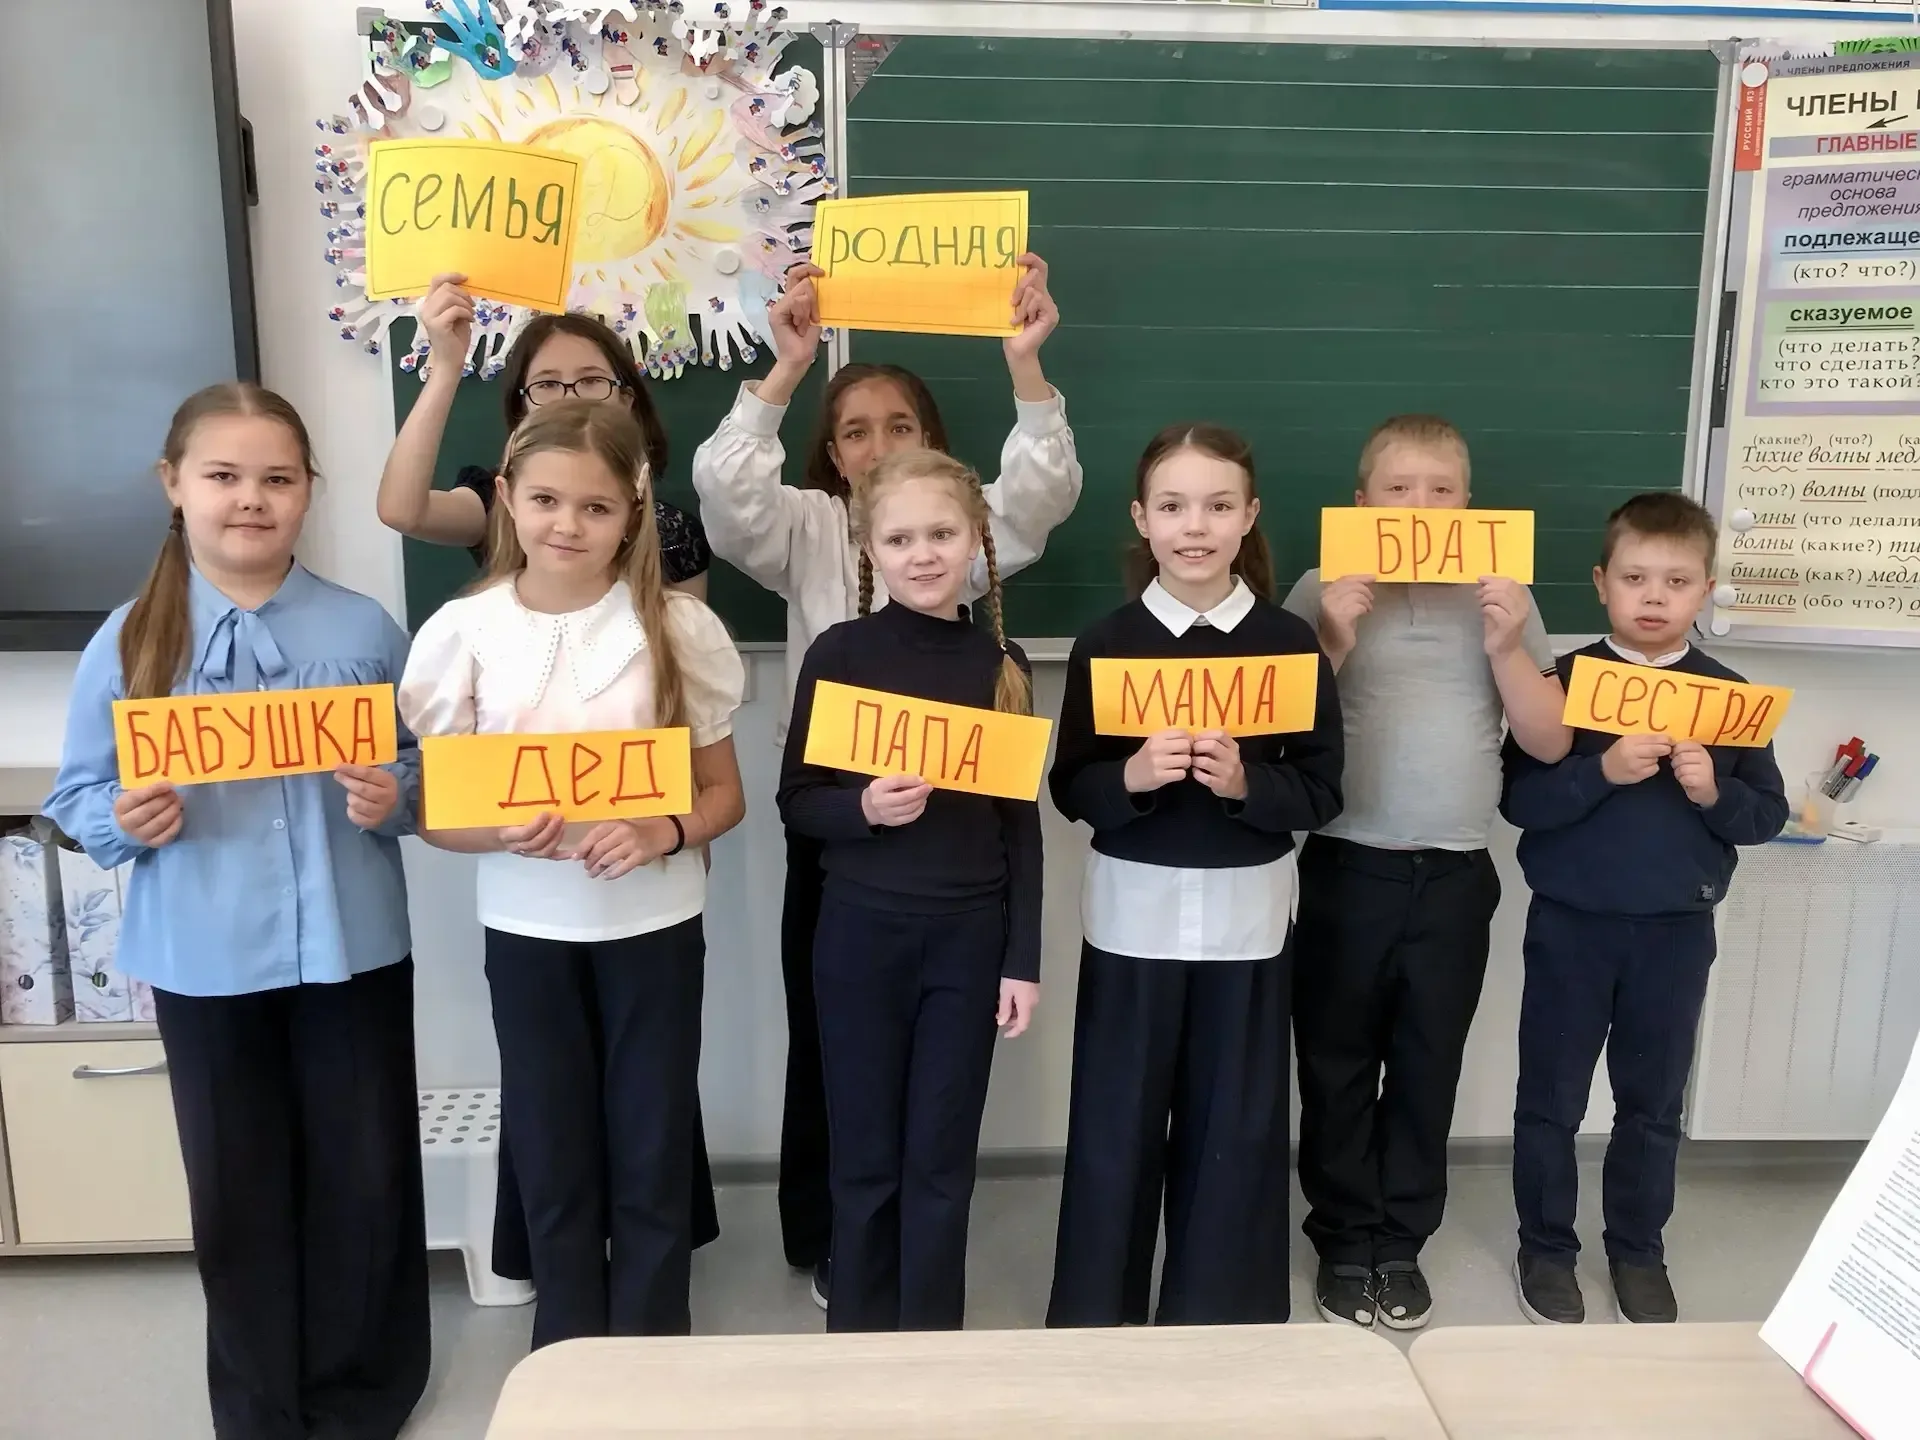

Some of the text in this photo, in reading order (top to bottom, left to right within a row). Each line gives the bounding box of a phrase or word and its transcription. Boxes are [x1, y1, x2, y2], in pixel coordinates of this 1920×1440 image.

[1787, 66, 1825, 76] ЧЛЕНЫ
[1828, 60, 1911, 73] ПРЕДЛОЖЕНИЯ
[1787, 90, 1897, 117] ЧЛЕНЫ
[1743, 108, 1754, 151] РУССКИЙ
[1817, 133, 1918, 153] ГЛАВНЫЕ
[1830, 186, 1897, 201] основа
[829, 225, 1016, 279] РОДНАЯ
[1793, 260, 1916, 283] (кто? что?)
[1790, 305, 1913, 324] сказуемое
[1778, 336, 1920, 358] (что делать?
[1774, 354, 1920, 372] что сделать?
[1760, 378, 1795, 389] кто
[1804, 377, 1839, 389] это
[1753, 434, 1813, 447] (какие?)
[1829, 433, 1873, 447] (что?)
[1742, 446, 1803, 464] Тихие
[1808, 446, 1871, 464] волны
[1738, 483, 1795, 500] (что?)
[1802, 480, 1867, 498] волны
[1803, 512, 1842, 529] (что
[1377, 514, 1507, 581] БРАТ
[1733, 533, 1794, 550] волны
[1801, 539, 1882, 556] (какие?)
[1731, 562, 1799, 580] бились
[1805, 568, 1862, 584] (как?)
[1803, 594, 1843, 610] (обо
[1852, 596, 1903, 613] что?)
[1121, 665, 1276, 728] МАМА
[127, 697, 377, 778] БАБУШКА
[850, 700, 983, 784] ПАПА
